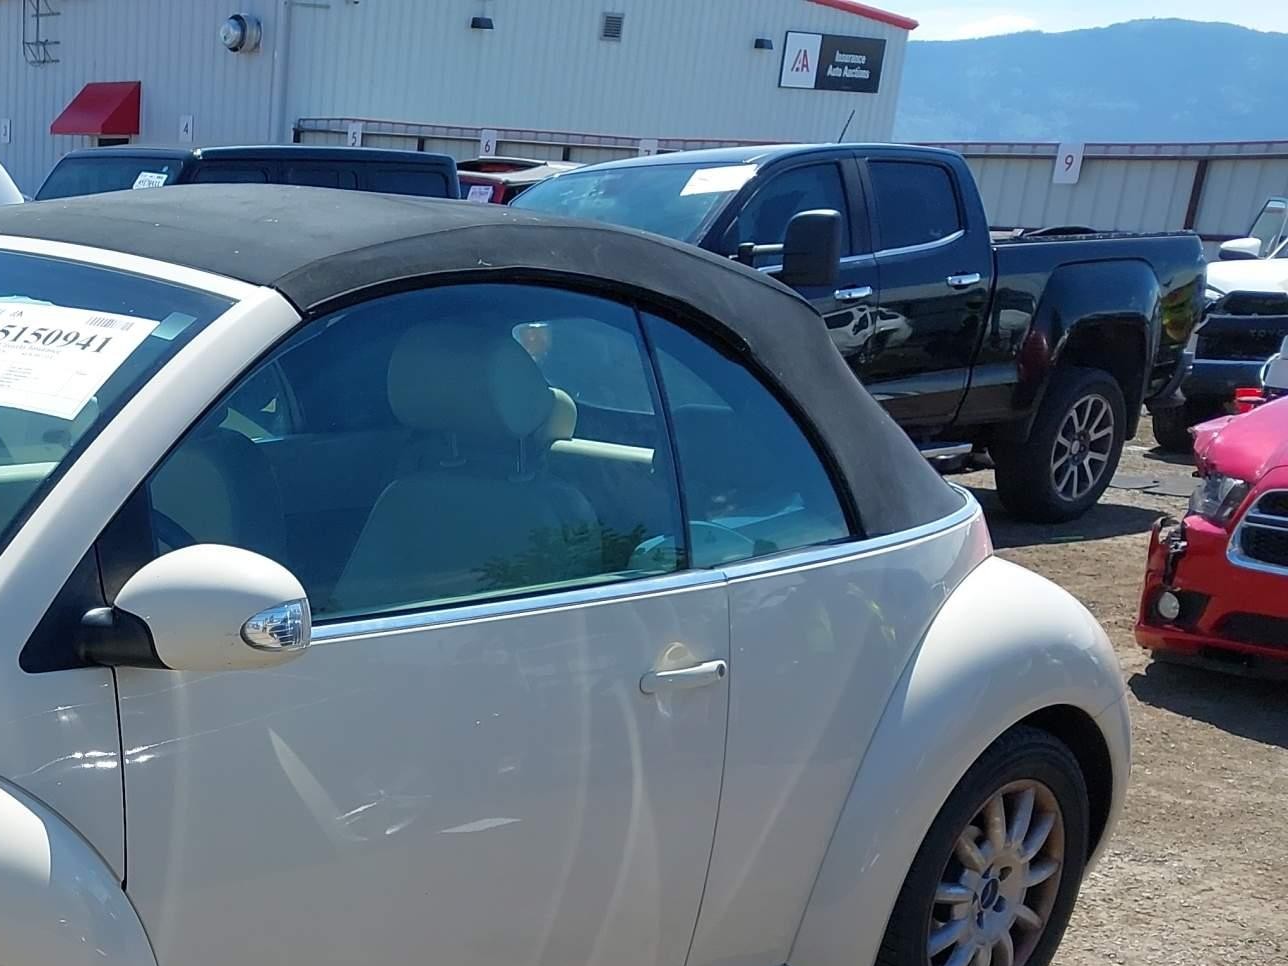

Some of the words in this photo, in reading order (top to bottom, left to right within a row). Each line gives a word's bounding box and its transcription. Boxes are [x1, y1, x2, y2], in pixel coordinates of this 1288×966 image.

[835, 50, 866, 64] Insurance
[827, 64, 842, 77] Auto
[843, 65, 870, 79] Auctions
[184, 122, 190, 135] 4
[351, 132, 357, 146] 5
[484, 139, 491, 153] 6
[1064, 154, 1074, 172] 9
